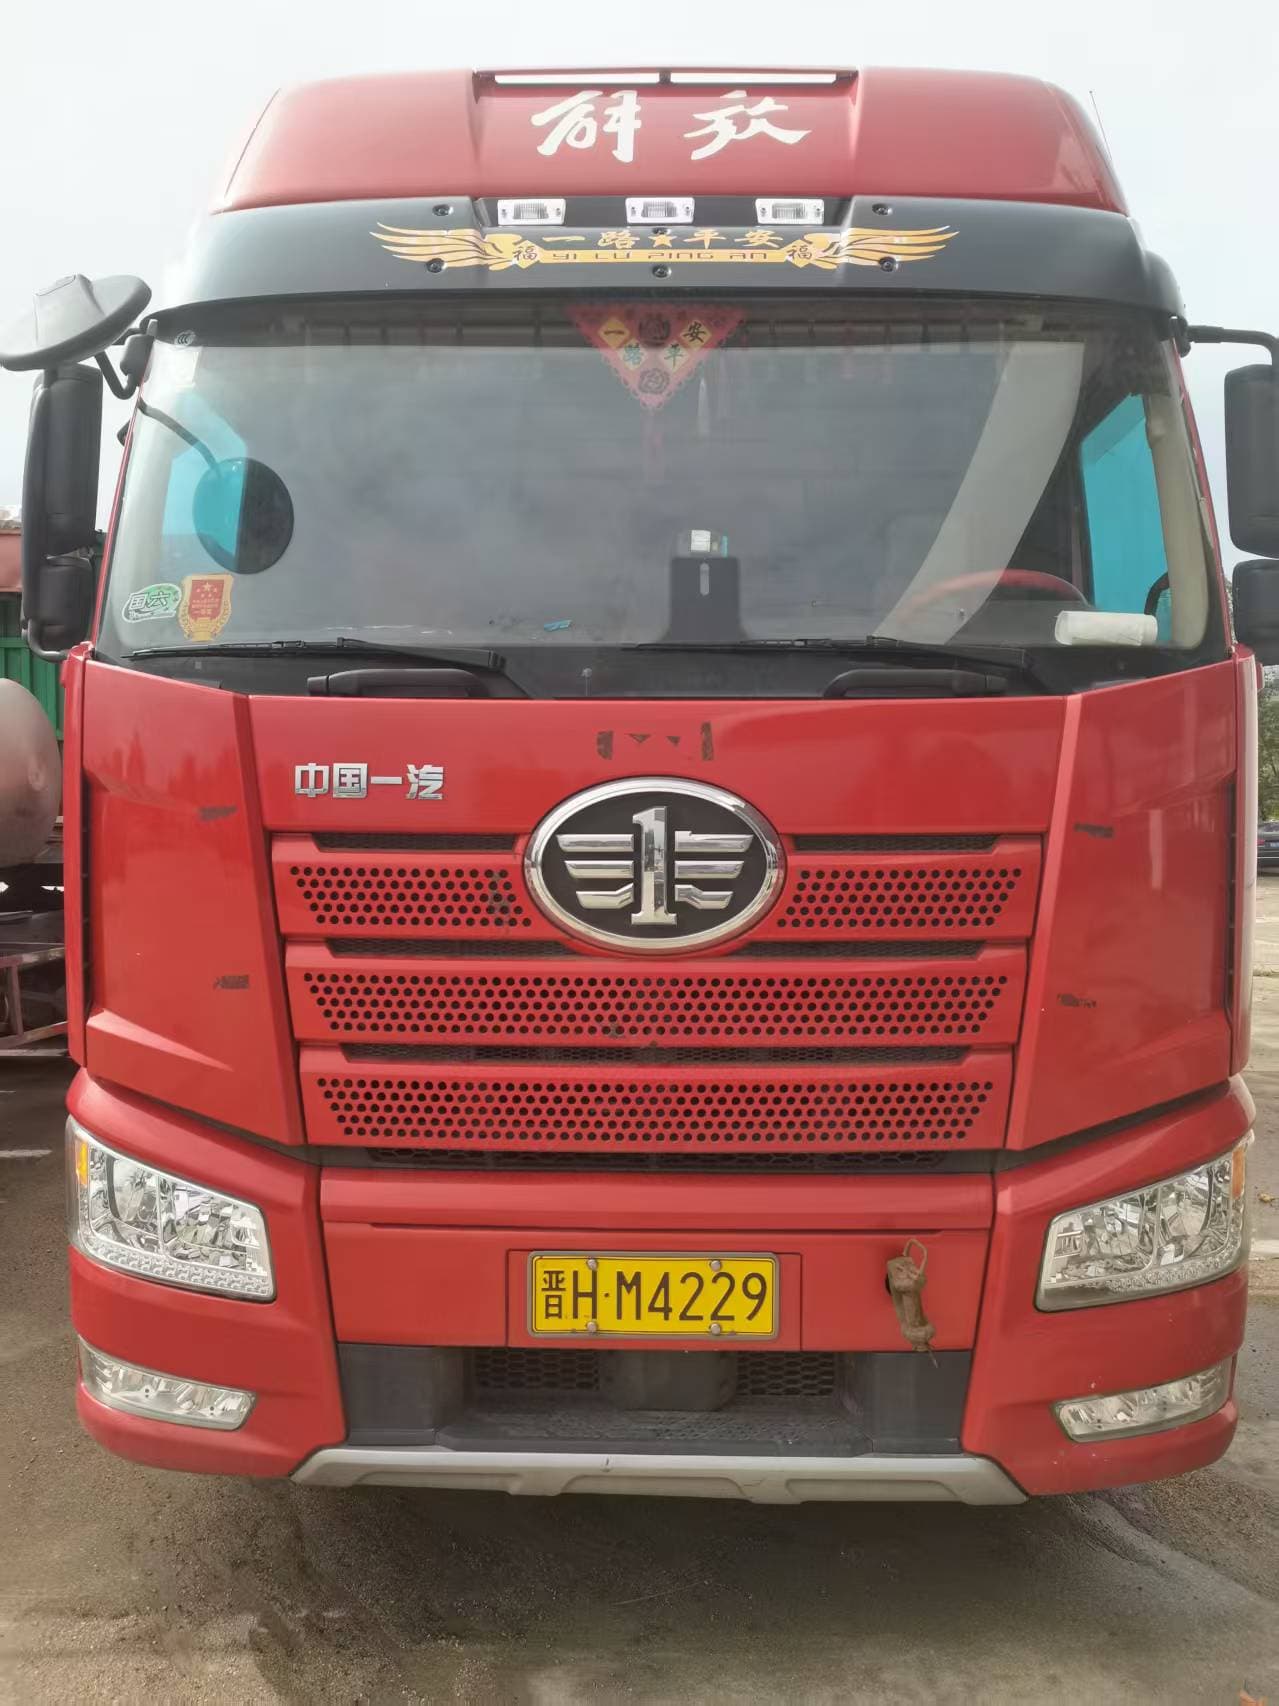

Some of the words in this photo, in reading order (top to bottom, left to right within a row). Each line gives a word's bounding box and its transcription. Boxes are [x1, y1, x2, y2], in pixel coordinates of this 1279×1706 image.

[531, 90, 812, 163] 解放
[512, 244, 538, 261] 福
[787, 245, 813, 260] 福
[129, 591, 171, 610] 国六
[295, 762, 444, 800] 中国一汽
[541, 1270, 768, 1321] 晋H·M4229
